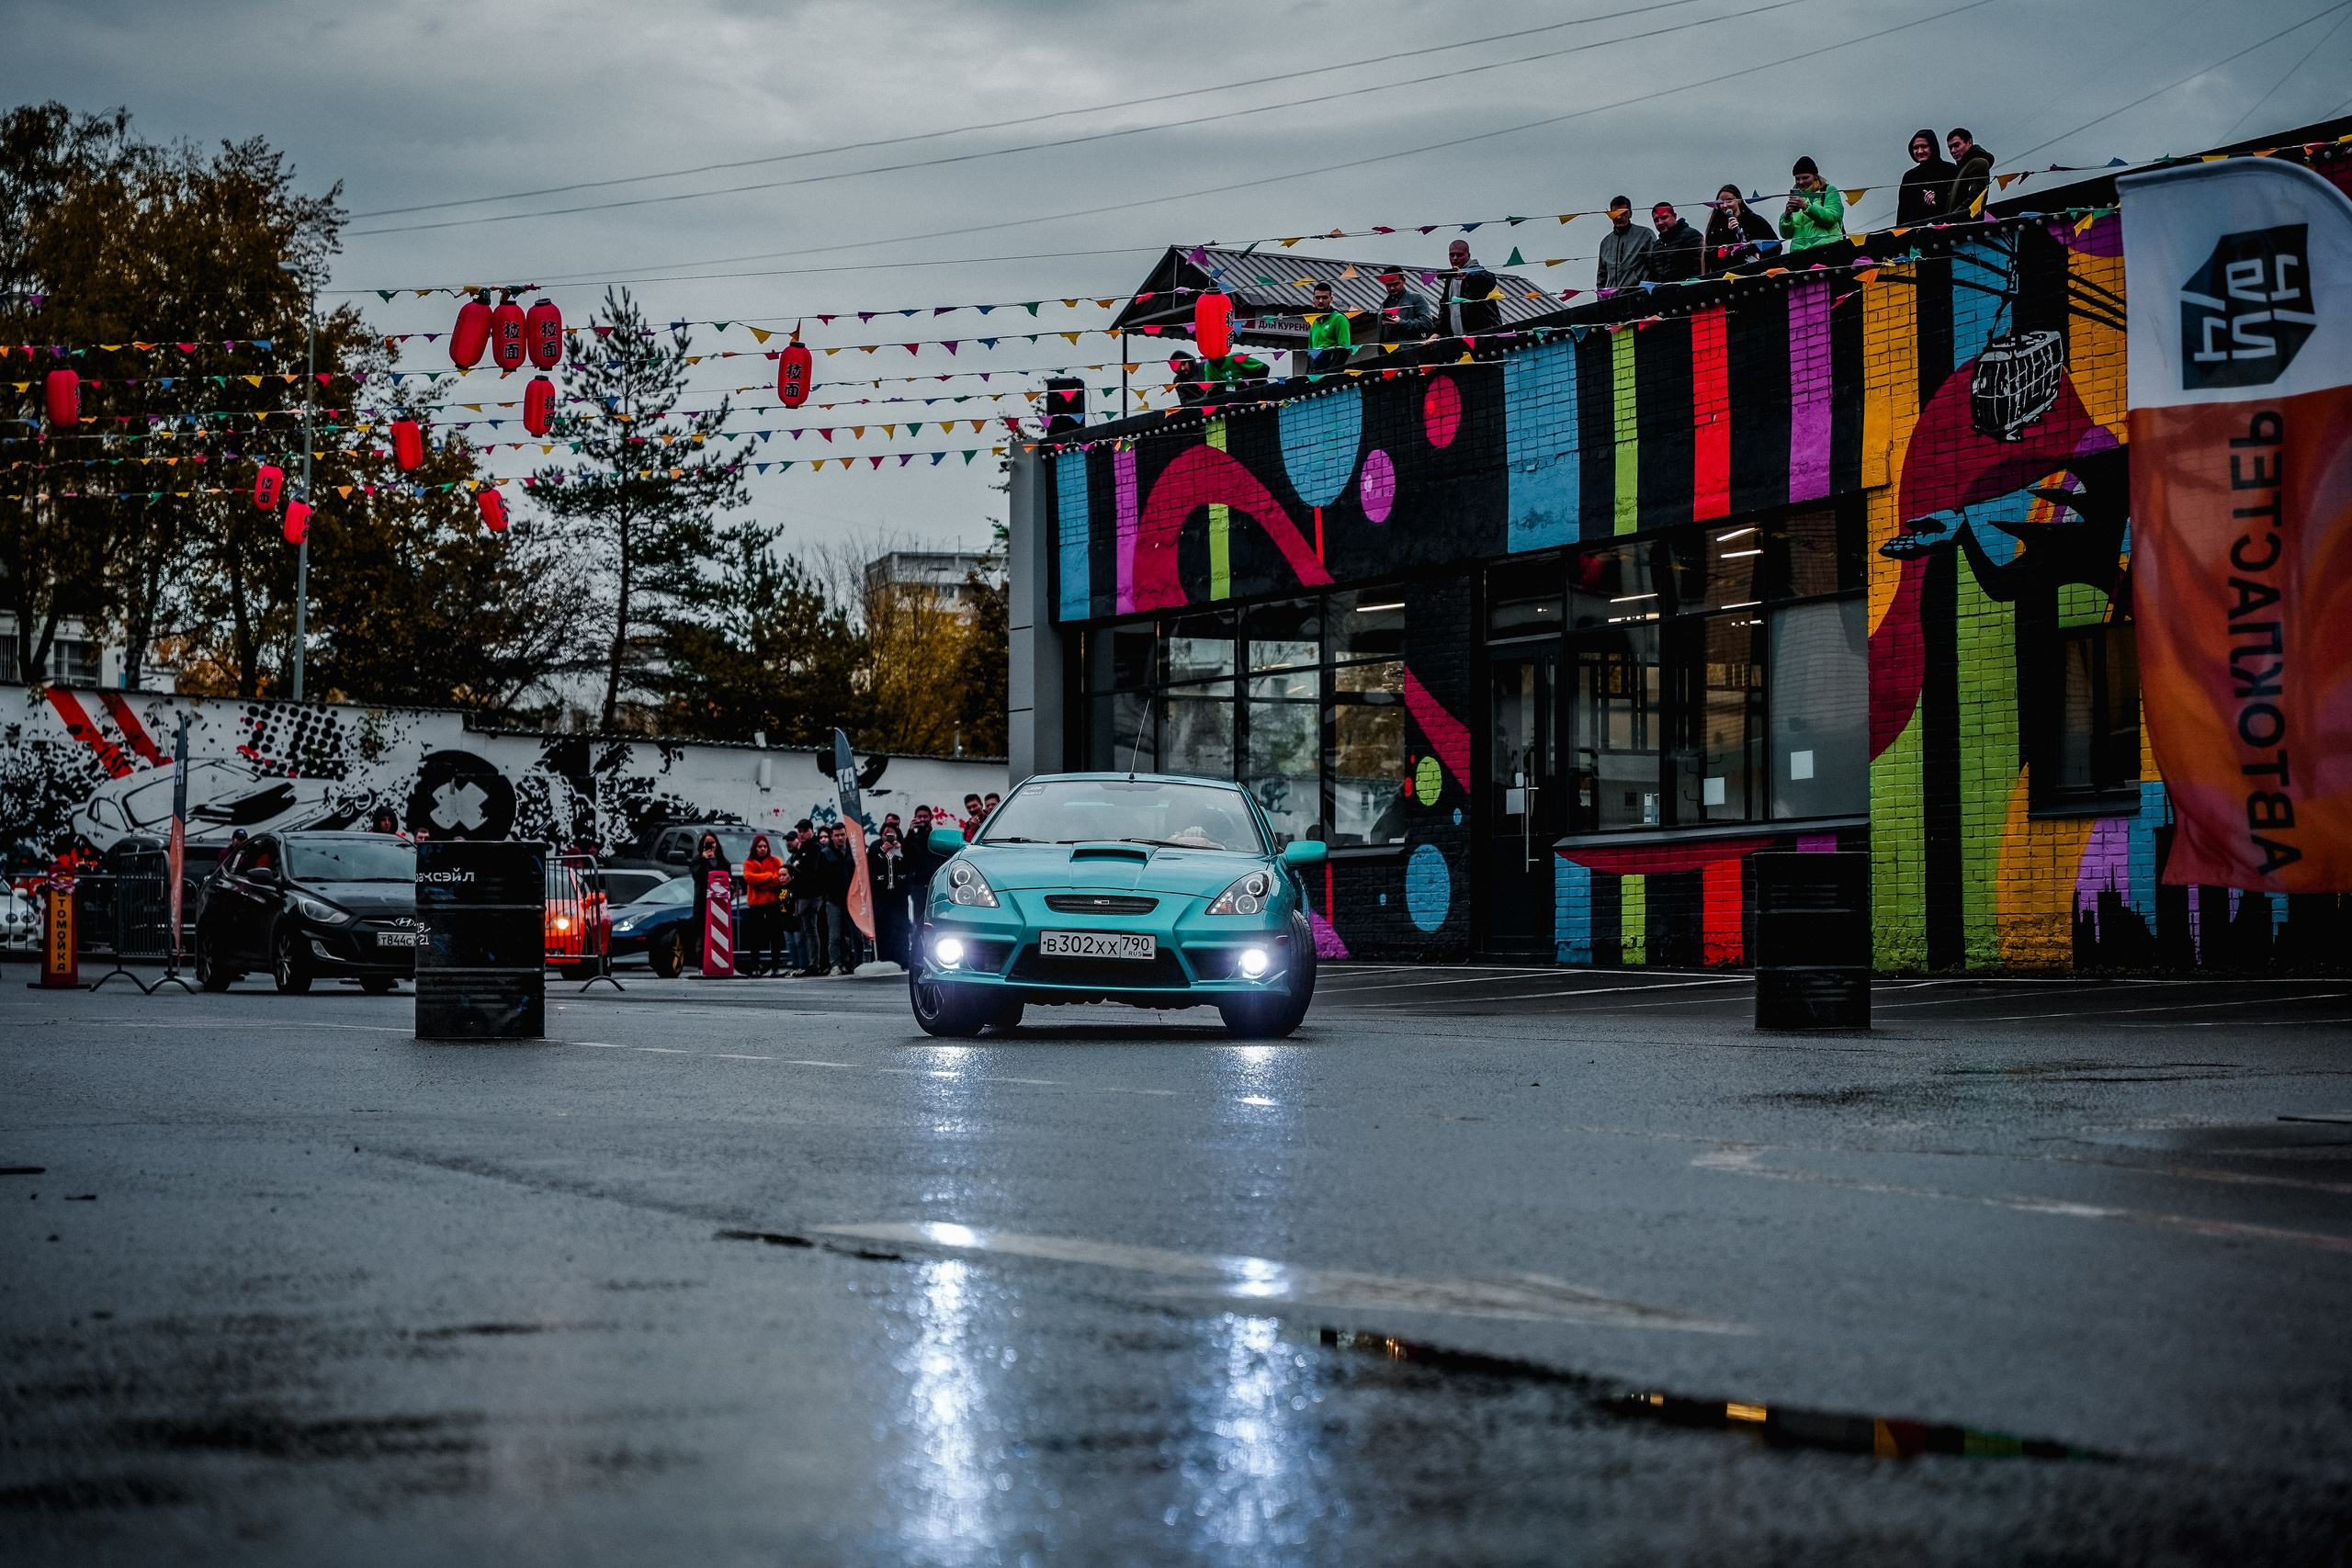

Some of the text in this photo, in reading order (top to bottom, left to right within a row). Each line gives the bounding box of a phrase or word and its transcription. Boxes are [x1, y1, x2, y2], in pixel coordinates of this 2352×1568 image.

[504, 322, 520, 359] 拉面
[541, 321, 558, 357] 拉面
[1122, 936, 1149, 951] 790
